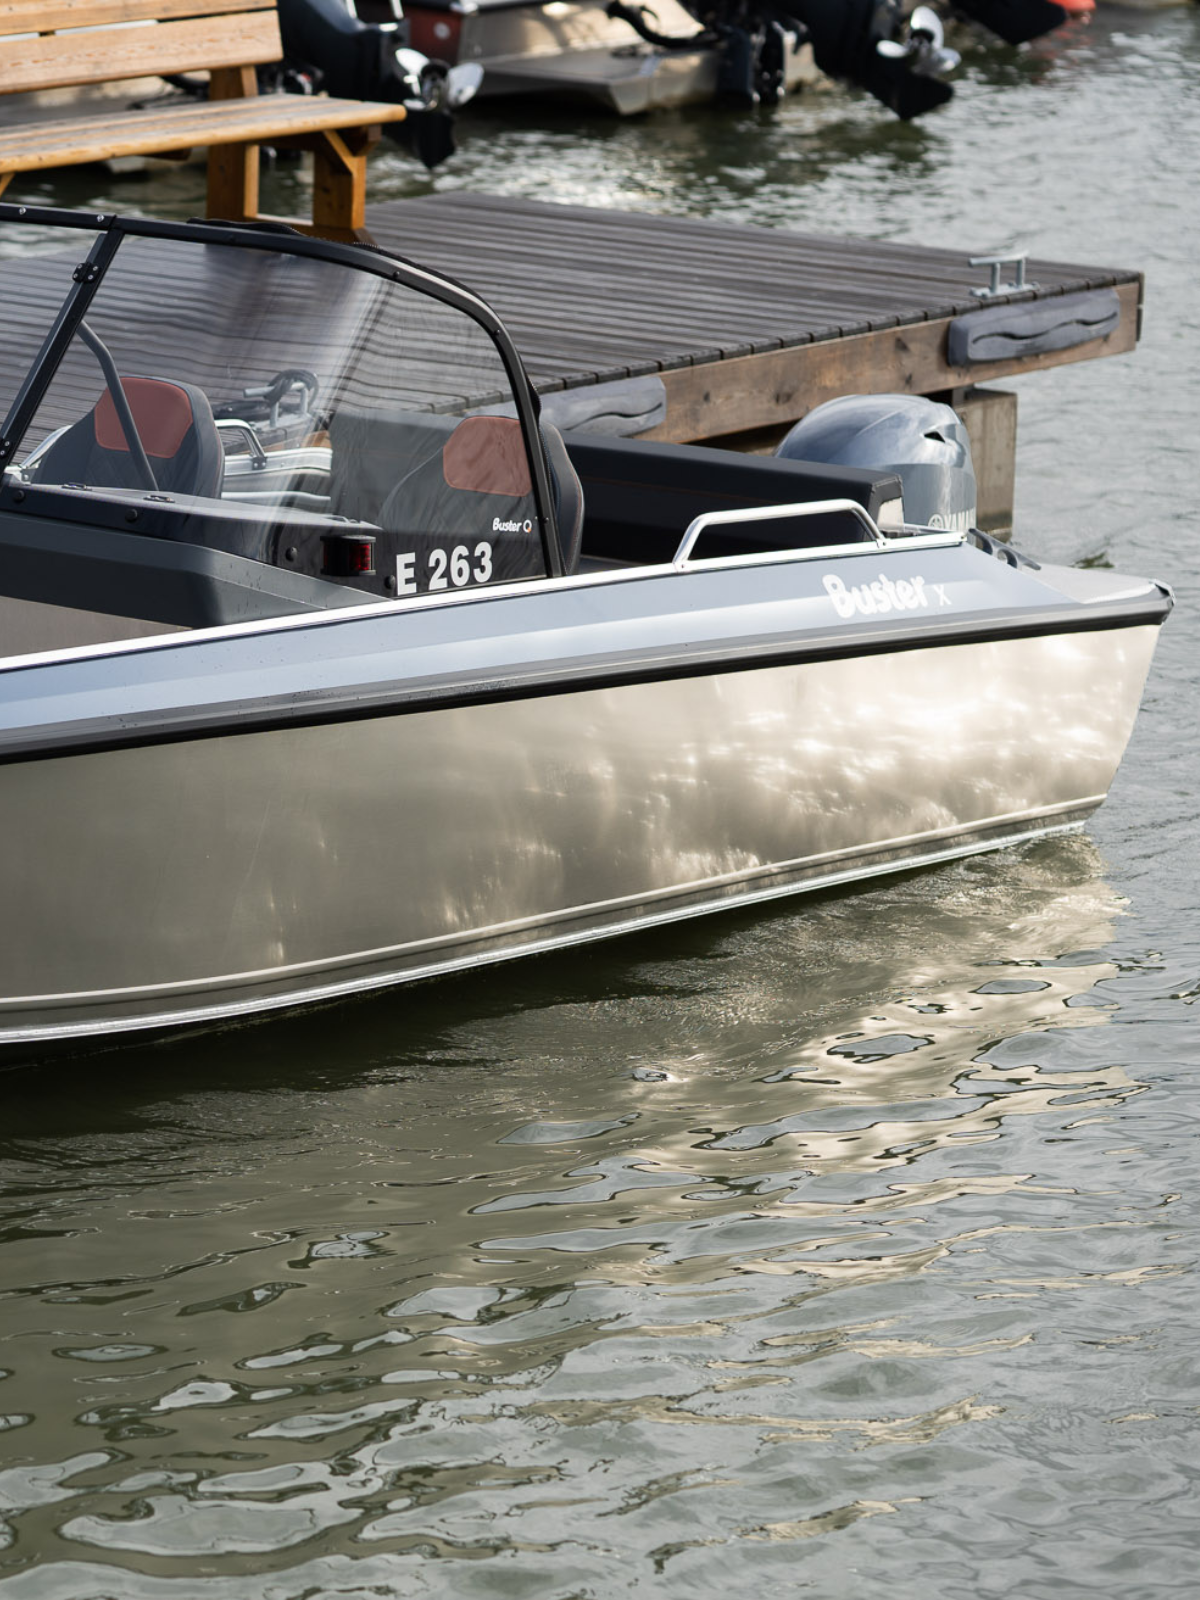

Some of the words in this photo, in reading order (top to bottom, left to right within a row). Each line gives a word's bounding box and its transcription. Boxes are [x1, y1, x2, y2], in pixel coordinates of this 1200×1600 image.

[492, 517, 522, 532] Buster
[396, 552, 417, 596] E
[428, 541, 493, 590] 263
[822, 574, 928, 618] Buster
